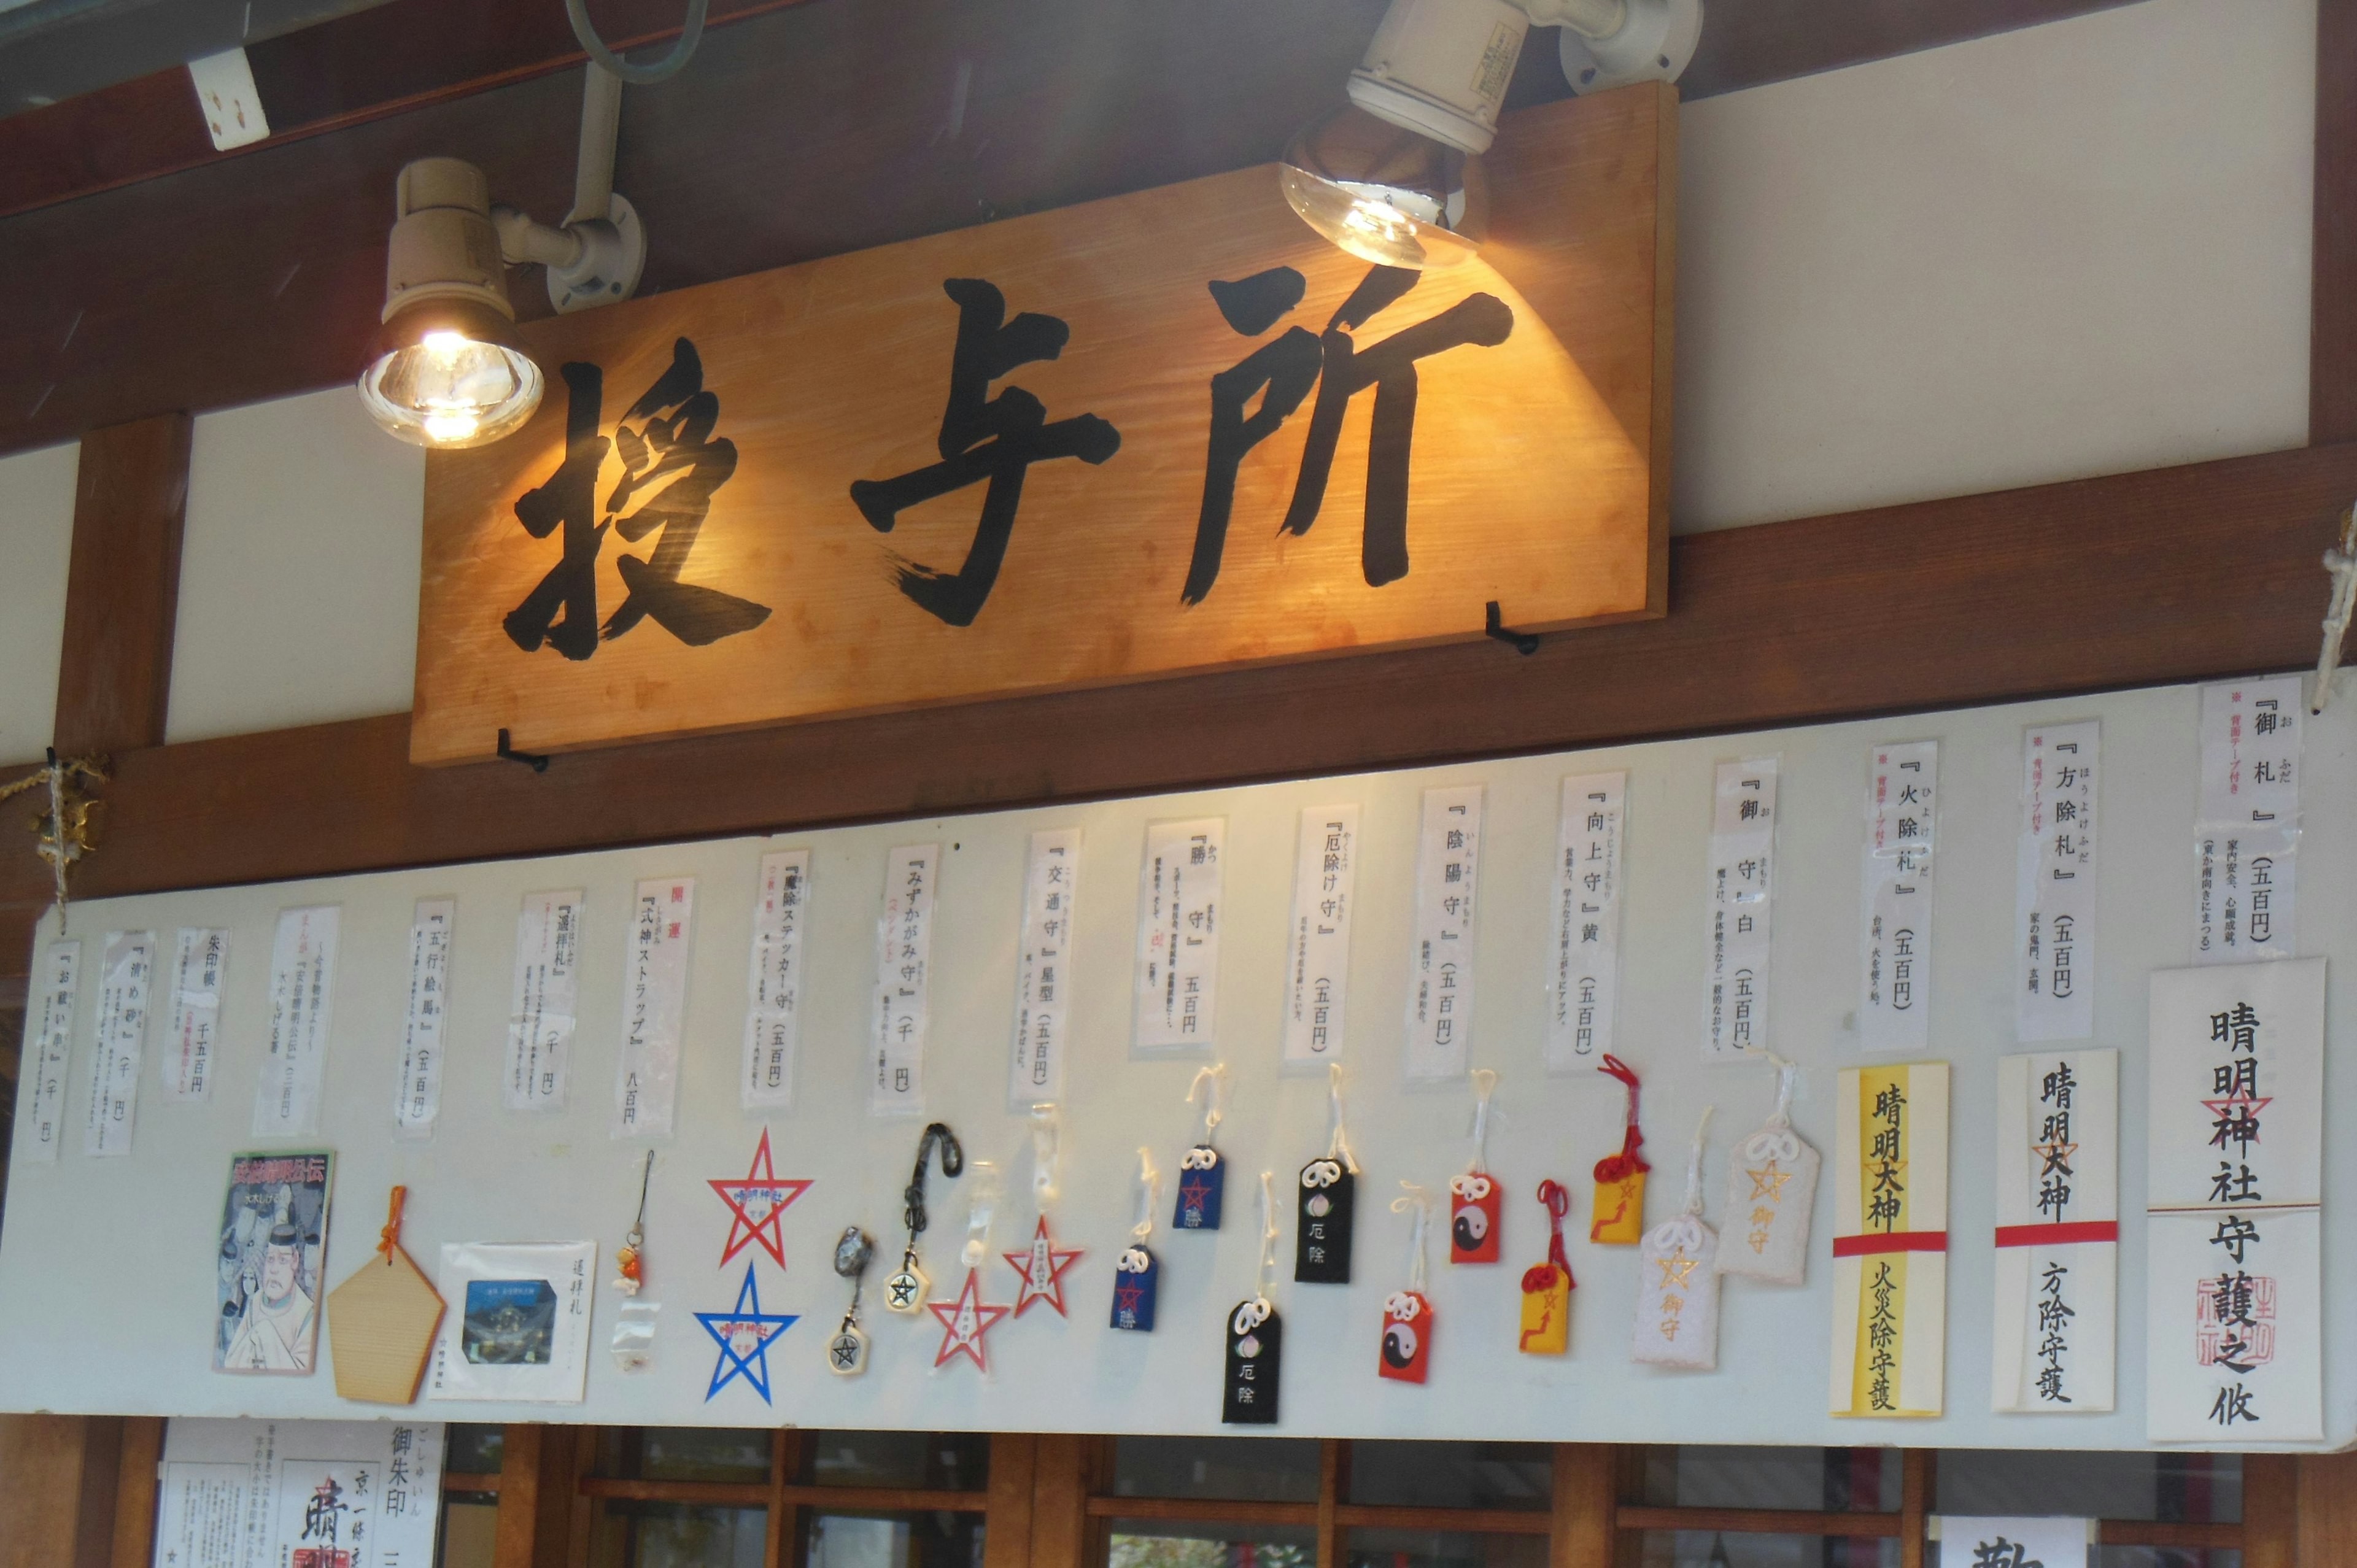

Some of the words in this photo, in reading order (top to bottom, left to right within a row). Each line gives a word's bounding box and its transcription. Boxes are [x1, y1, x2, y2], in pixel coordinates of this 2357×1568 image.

[502, 267, 1516, 661] 授与所
[2230, 714, 2242, 795] 背面テープ付き
[1895, 761, 1921, 894] 『火除札』
[2054, 743, 2078, 880] 『方除札』
[2079, 768, 2090, 864] ほうよけふだ
[1318, 821, 1343, 935] 『厄除け守』
[2250, 857, 2272, 943] （五百円）
[630, 897, 656, 1045] 『式神ストラップ』
[899, 860, 925, 996] 『みずかがみ守』
[1893, 929, 1914, 1010] （五百円）
[2052, 914, 2075, 998] （五百円）
[1311, 978, 1331, 1053] （五百円）
[1575, 977, 1596, 1056] （五百円）
[1867, 1083, 1908, 1233] 晴明大神
[2036, 1061, 2077, 1223] 晴明大神
[733, 1189, 783, 1204] 晴明神社
[1747, 1205, 1775, 1254] 御守
[1309, 1224, 1325, 1264] 厄除
[719, 1322, 768, 1338] 晴明神社
[1660, 1293, 1685, 1342] 御守
[1867, 1262, 1897, 1411] 火災除守護
[2035, 1262, 2075, 1404] 方除守護
[1238, 1364, 1255, 1404] 厄除
[387, 1426, 412, 1518] 御朱印
[411, 1427, 428, 1517] ごしゅいん
